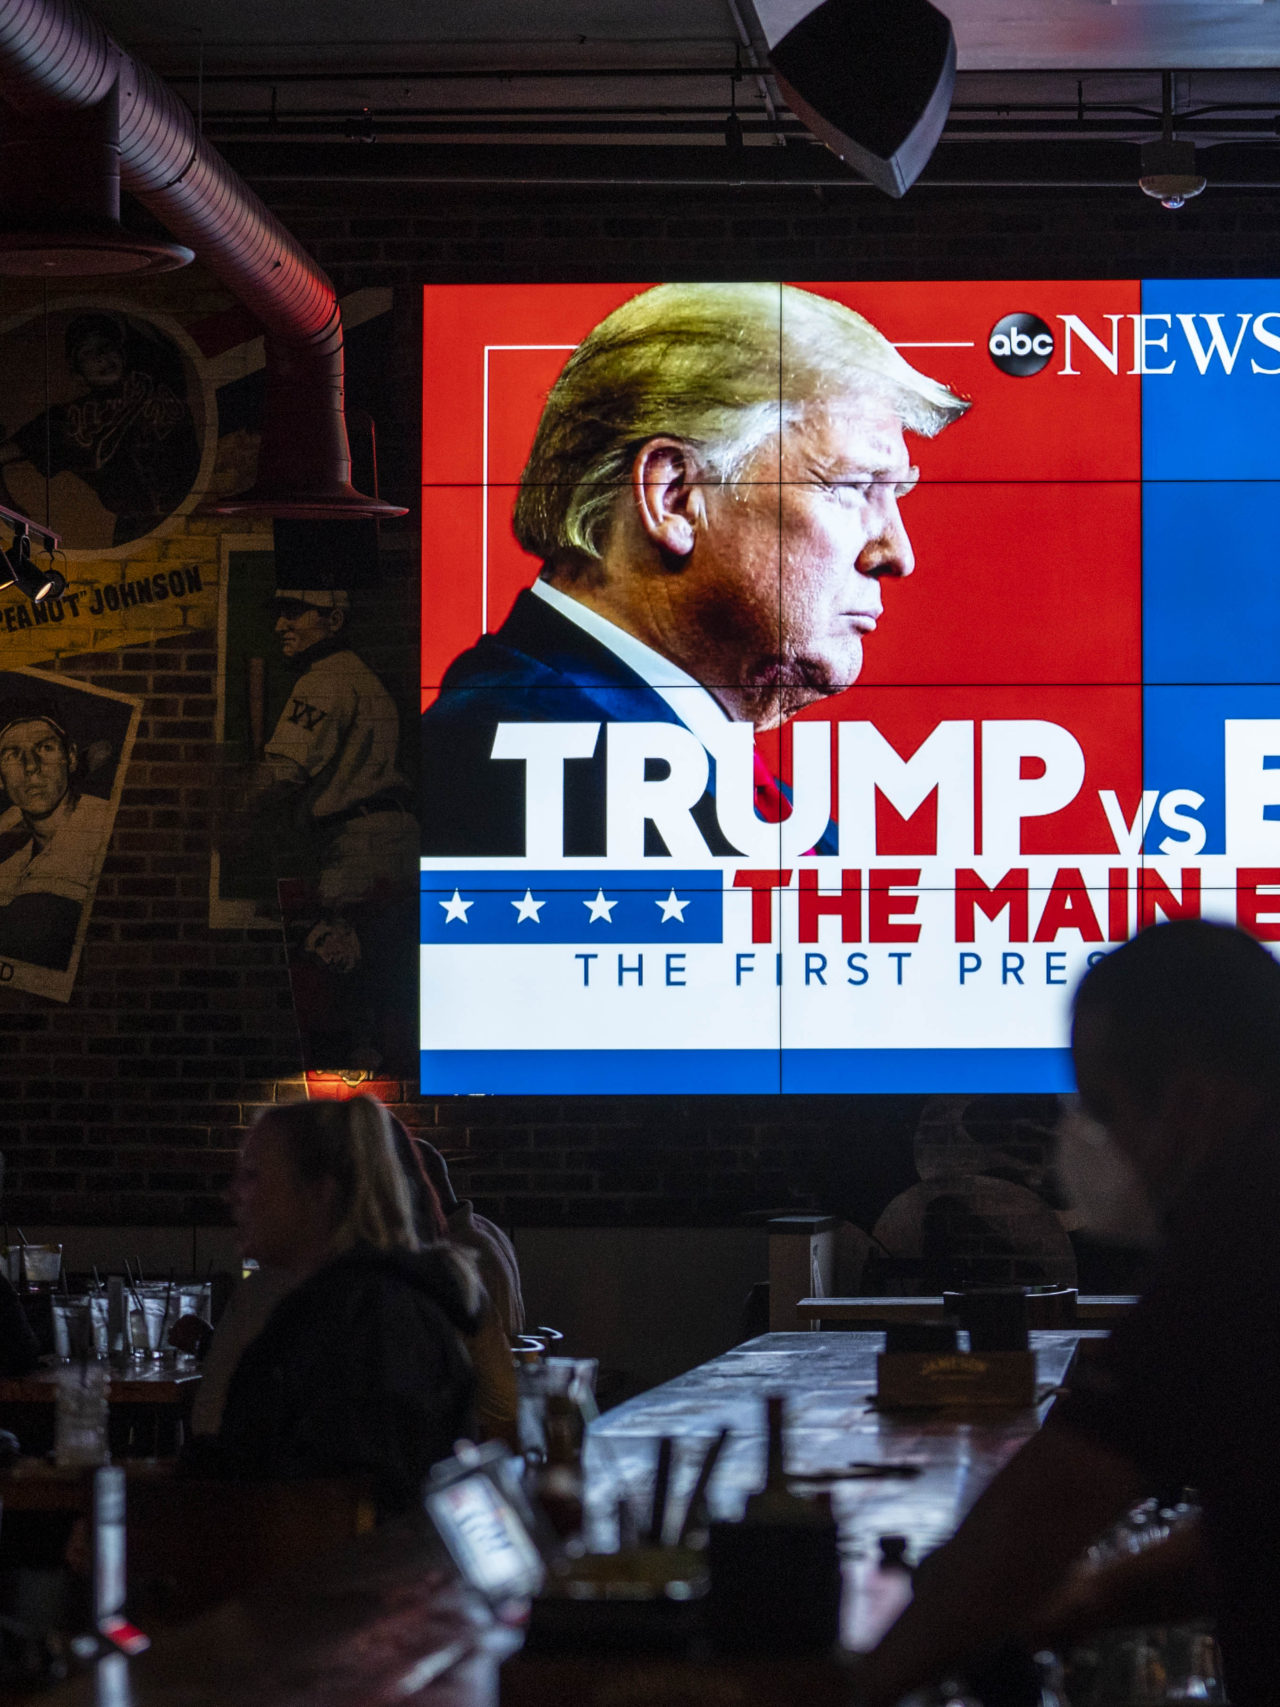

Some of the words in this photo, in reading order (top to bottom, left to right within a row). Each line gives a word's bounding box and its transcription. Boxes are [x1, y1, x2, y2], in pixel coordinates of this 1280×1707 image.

[989, 326, 1054, 357] abc
[90, 566, 202, 615] JOHNSON
[491, 719, 1086, 857] TRUMP
[732, 867, 922, 944] THE
[954, 867, 1202, 943] MAIN
[574, 952, 688, 986] THE
[735, 952, 913, 986] FIRST
